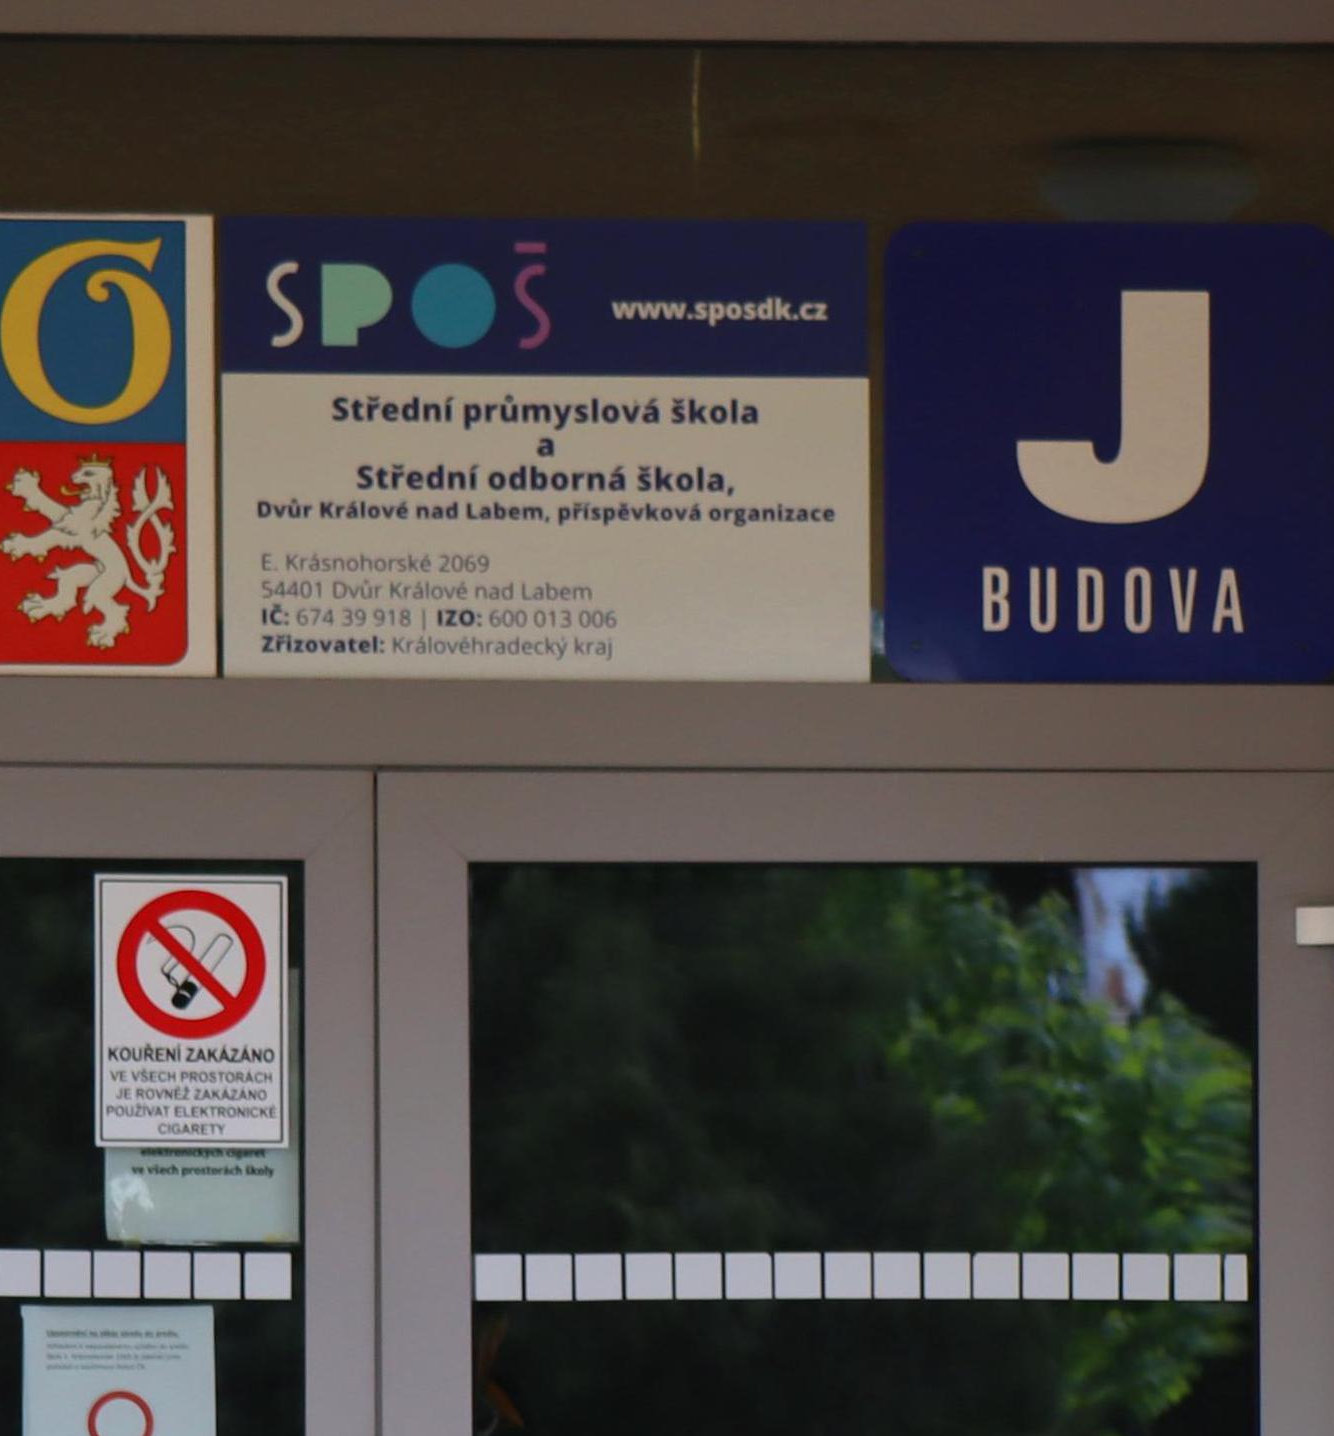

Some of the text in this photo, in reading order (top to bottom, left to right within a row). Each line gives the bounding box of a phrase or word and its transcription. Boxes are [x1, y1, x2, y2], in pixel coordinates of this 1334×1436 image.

[267, 242, 550, 349] SPOŠ
[612, 297, 828, 327] www.sposdk.cz
[331, 395, 759, 430] Střední průmyslová škola
[1016, 289, 1210, 524] J
[537, 437, 555, 457] a
[357, 465, 734, 496] Střední odborná škola,
[257, 499, 835, 527] Dvůr Králové nad Labem, příspěvková organizace
[262, 554, 489, 574] E. Krásnohorské 2069
[262, 580, 592, 602] 54401 Dvůr Králové nad Labem
[982, 566, 1244, 634] BUDOVA
[262, 606, 289, 627] IČ:
[296, 609, 335, 628] 674
[342, 609, 371, 628] 39
[375, 609, 411, 628] 918
[438, 609, 482, 628] IZO:
[489, 609, 526, 629] 600
[533, 610, 572, 629] 013
[579, 610, 617, 630] 006
[262, 634, 613, 661] Zřizovatel: Královéhradecký kraj
[108, 1043, 275, 1063] KOUŘENÍ ZAKÁZÁNO
[110, 1068, 272, 1084] VE VŠECH PROSTORÁCH
[116, 1086, 267, 1101] JE ROVNĚŽ ZAKÁZÁNO
[106, 1103, 277, 1119] POUŽÍVAT ELEKTRONICKÉ
[158, 1123, 226, 1135] CIGARETY
[227, 1150, 266, 1160] cigaret
[132, 1165, 275, 1178] ve všech prostorách školy
